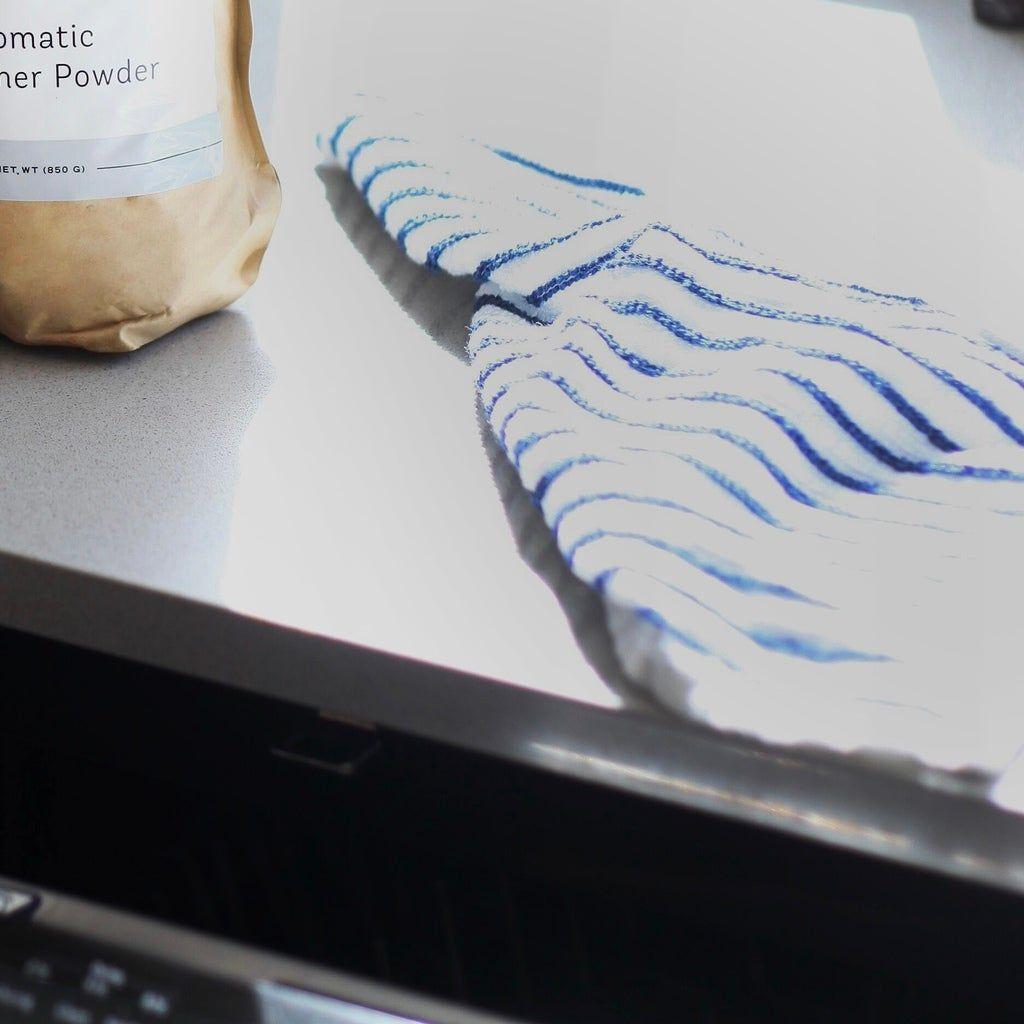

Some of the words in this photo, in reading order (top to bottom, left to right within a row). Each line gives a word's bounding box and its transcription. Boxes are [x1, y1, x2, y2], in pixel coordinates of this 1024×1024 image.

[55, 58, 161, 89] Powder
[21, 166, 39, 174] WT
[42, 166, 69, 175] (850
[73, 165, 86, 174] G)
